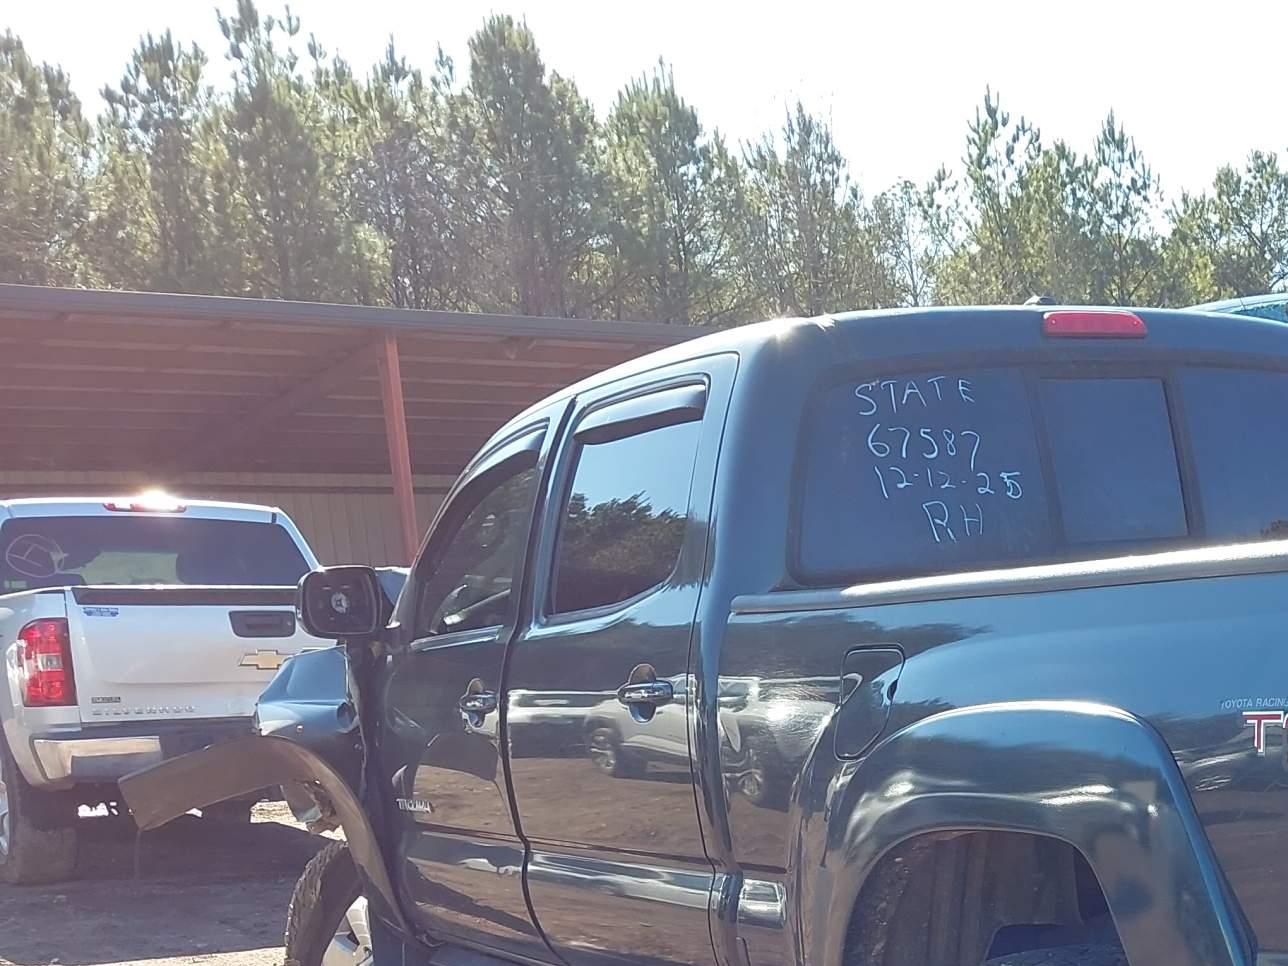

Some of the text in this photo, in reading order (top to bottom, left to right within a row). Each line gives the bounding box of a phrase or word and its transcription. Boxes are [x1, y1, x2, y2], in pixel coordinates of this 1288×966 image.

[855, 376, 975, 415] STATE
[868, 423, 980, 472] 67587
[922, 501, 983, 542] RH
[1221, 698, 1252, 709] TOYOTA
